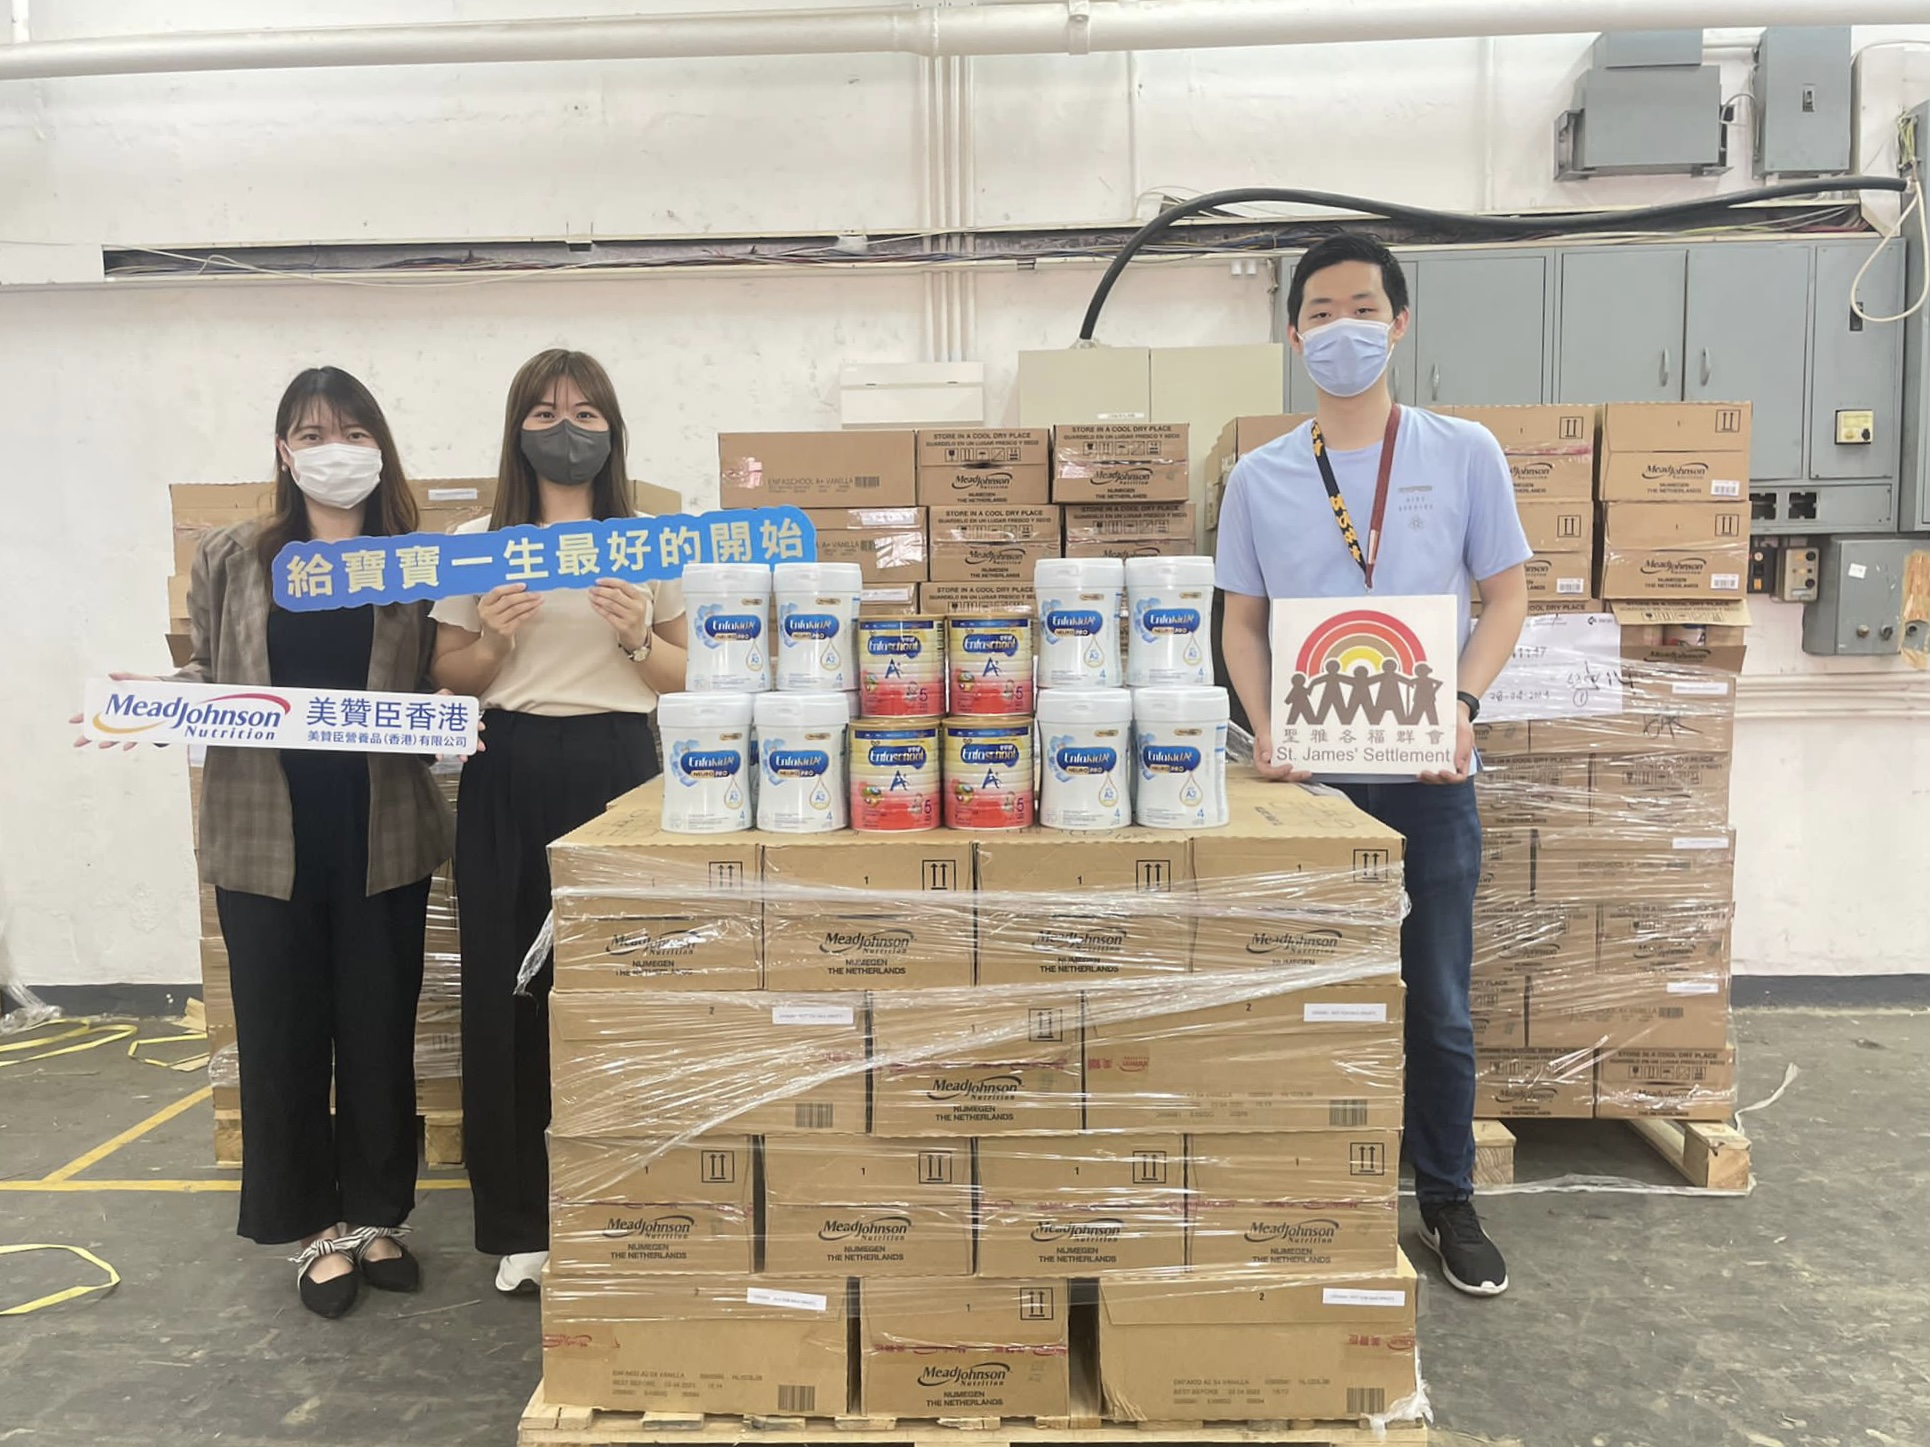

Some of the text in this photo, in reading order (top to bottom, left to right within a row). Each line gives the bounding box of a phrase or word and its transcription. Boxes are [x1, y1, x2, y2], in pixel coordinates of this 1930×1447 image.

[1647, 465, 1705, 477] MeadJohnson
[956, 475, 1010, 487] MeadJohnson
[286, 517, 804, 598] 給寶寶一生最好的開始
[919, 688, 928, 701] 5
[1015, 686, 1023, 699] 5
[105, 693, 281, 729] MeadJohnson
[306, 696, 469, 732] 美贊臣香港
[184, 726, 276, 740] Nutrition
[1276, 747, 1450, 763] St. James' Settlement
[924, 800, 931, 814] 5
[1017, 798, 1024, 812] 5
[864, 876, 869, 884] 1
[1078, 876, 1083, 885] 1
[825, 932, 910, 950] MeadJohnson
[1058, 965, 1119, 973] NETHERLANDS
[709, 1006, 714, 1015] 2
[1246, 1003, 1252, 1011] 2
[932, 1079, 1018, 1096] MeadJohnson
[953, 1113, 1014, 1121] NETHERLANDS
[645, 1166, 649, 1174] 1
[861, 1167, 866, 1176] 1
[1074, 1167, 1079, 1175] 1
[608, 1218, 690, 1235] MeadJohnson
[823, 1220, 907, 1237] MeadJohnson
[1251, 1222, 1334, 1239] MeadJohnson
[1056, 1255, 1117, 1263] NETHERLANDS
[1259, 1292, 1265, 1301] 2
[966, 1304, 971, 1313] 1
[923, 1366, 1006, 1382] MeadJohnson
[926, 1399, 1003, 1407] THE NETHERLANDS
